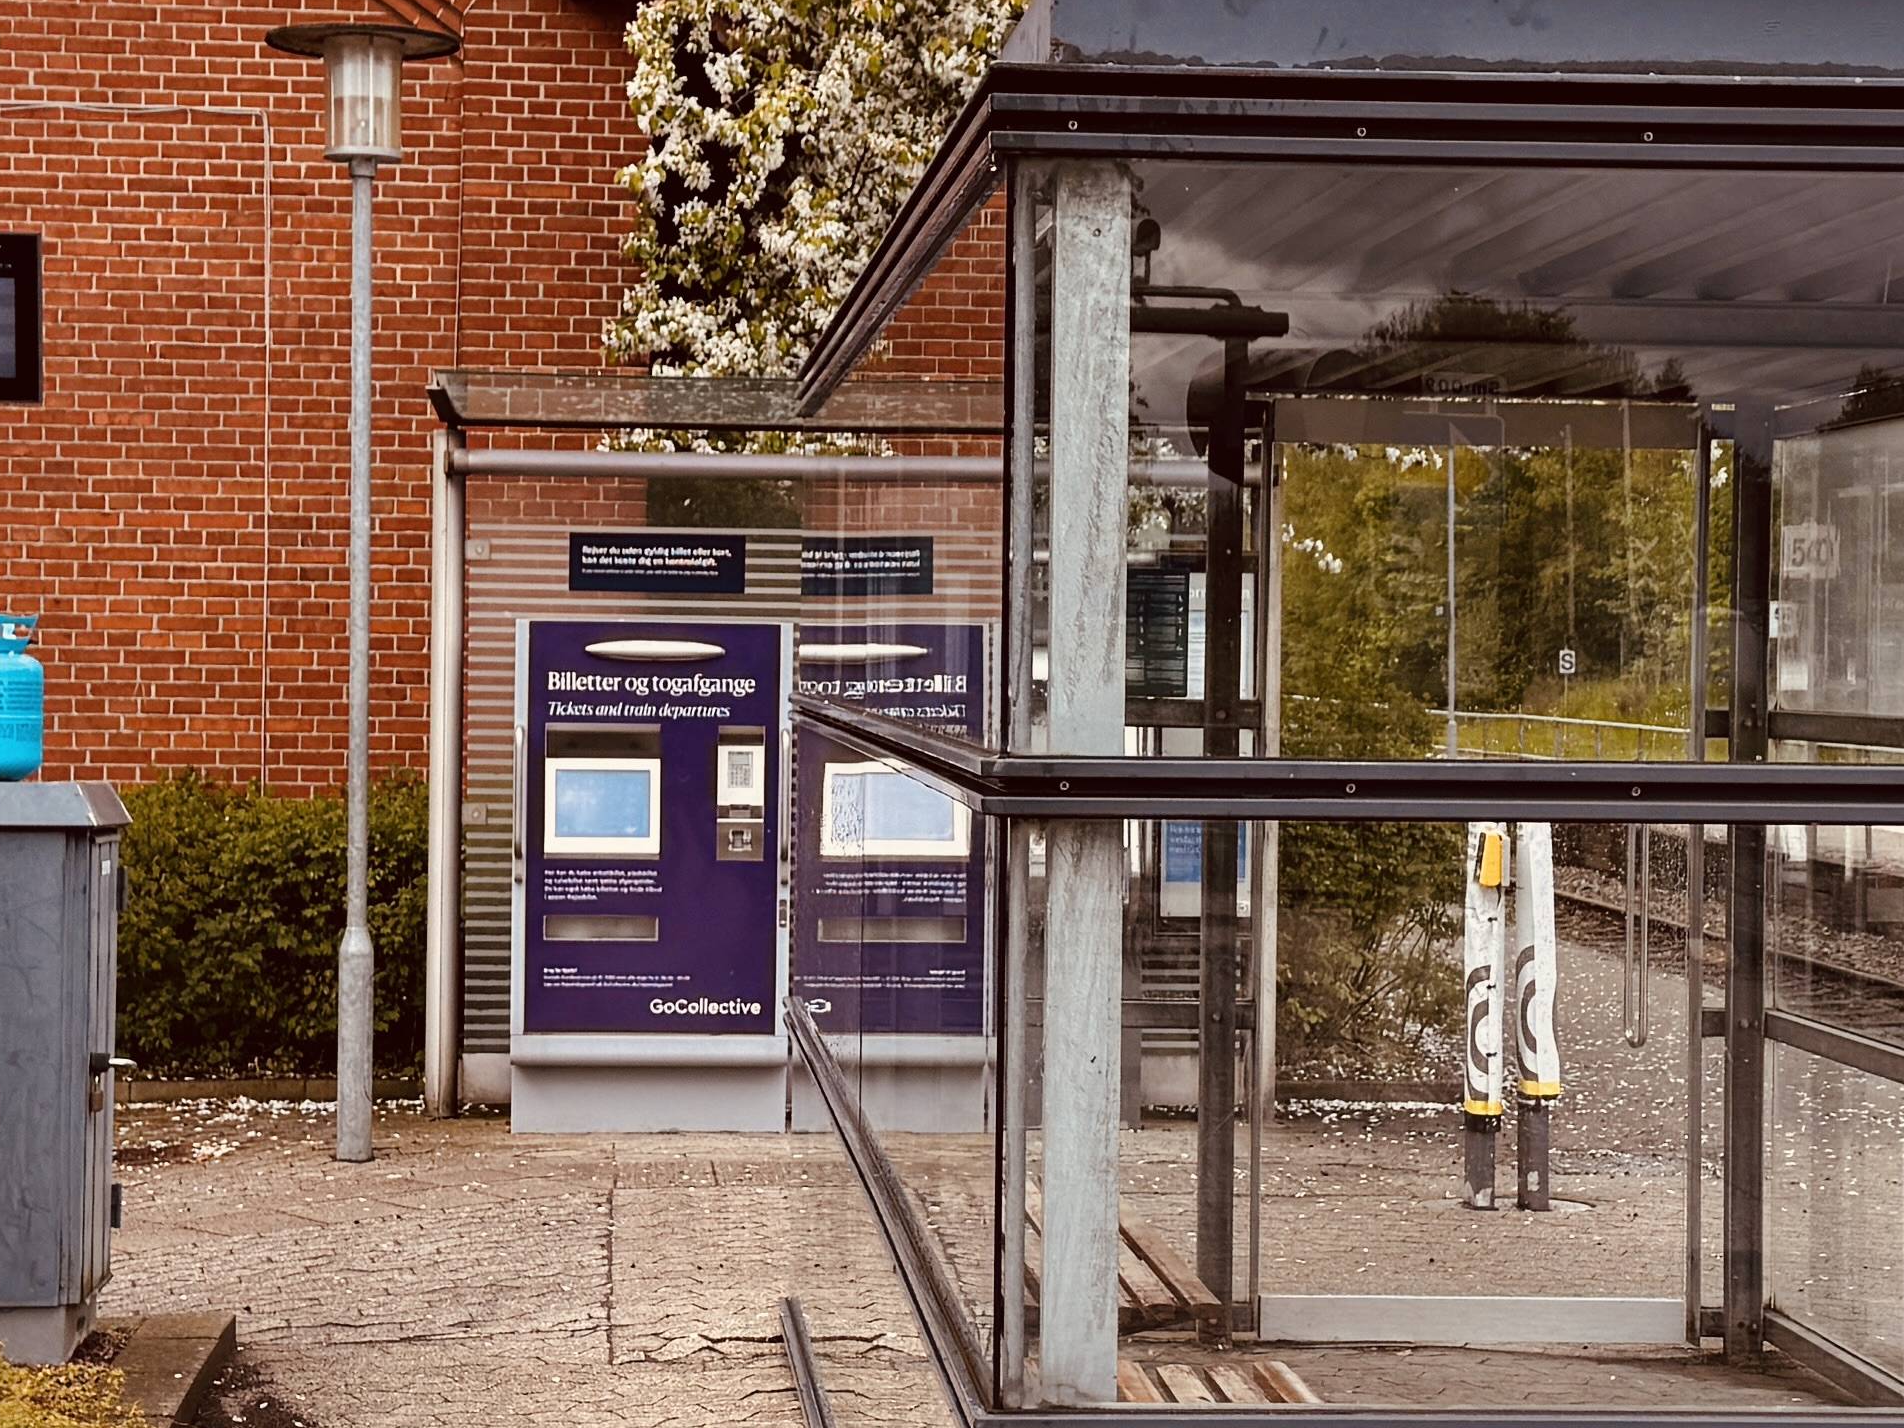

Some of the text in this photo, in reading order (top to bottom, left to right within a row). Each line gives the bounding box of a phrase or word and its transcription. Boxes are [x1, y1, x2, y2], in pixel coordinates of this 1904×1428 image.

[1561, 653, 1574, 671] S
[548, 671, 756, 697] Billetter og togafgange
[548, 701, 731, 720] Tickets and train departures
[649, 998, 762, 1015] GoCollective
